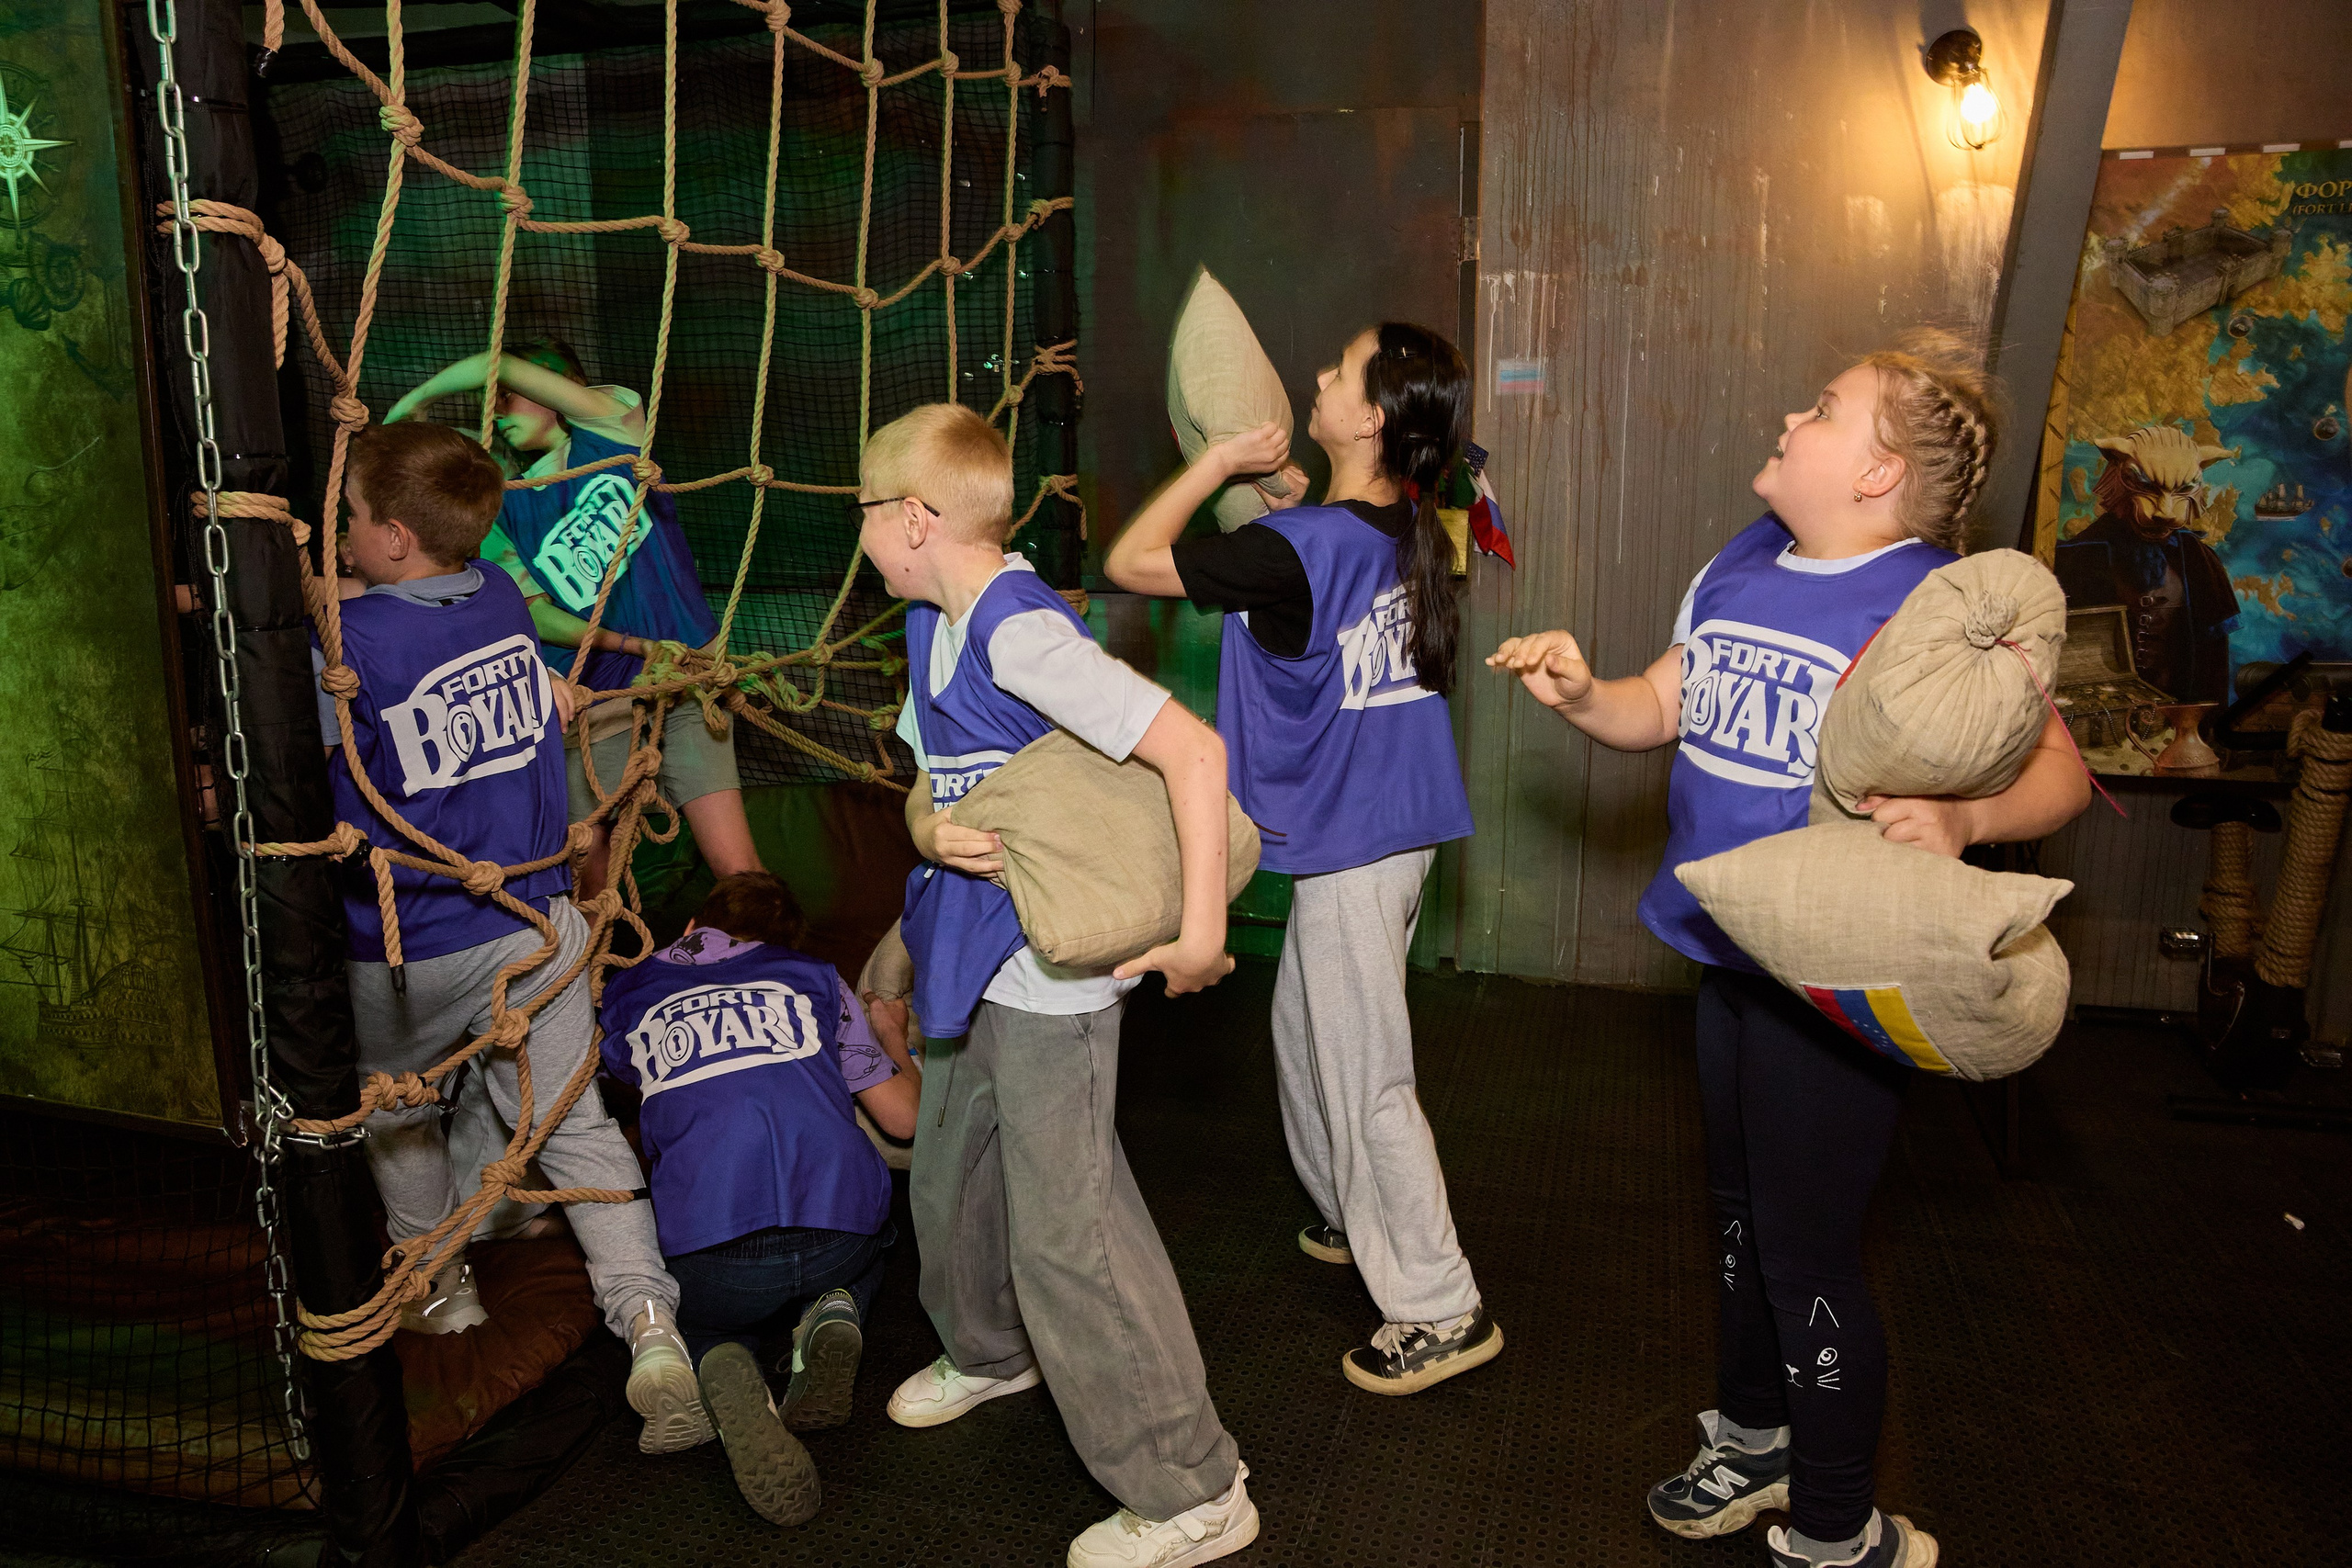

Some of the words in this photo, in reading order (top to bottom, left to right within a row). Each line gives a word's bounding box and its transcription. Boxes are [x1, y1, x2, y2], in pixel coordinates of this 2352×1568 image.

[1374, 599, 1413, 633] FOR
[441, 651, 521, 705] FORT
[1712, 637, 1812, 684] FORT
[929, 768, 983, 798] ORT
[662, 989, 758, 1023] FORT
[625, 990, 822, 1106] BOYARD
